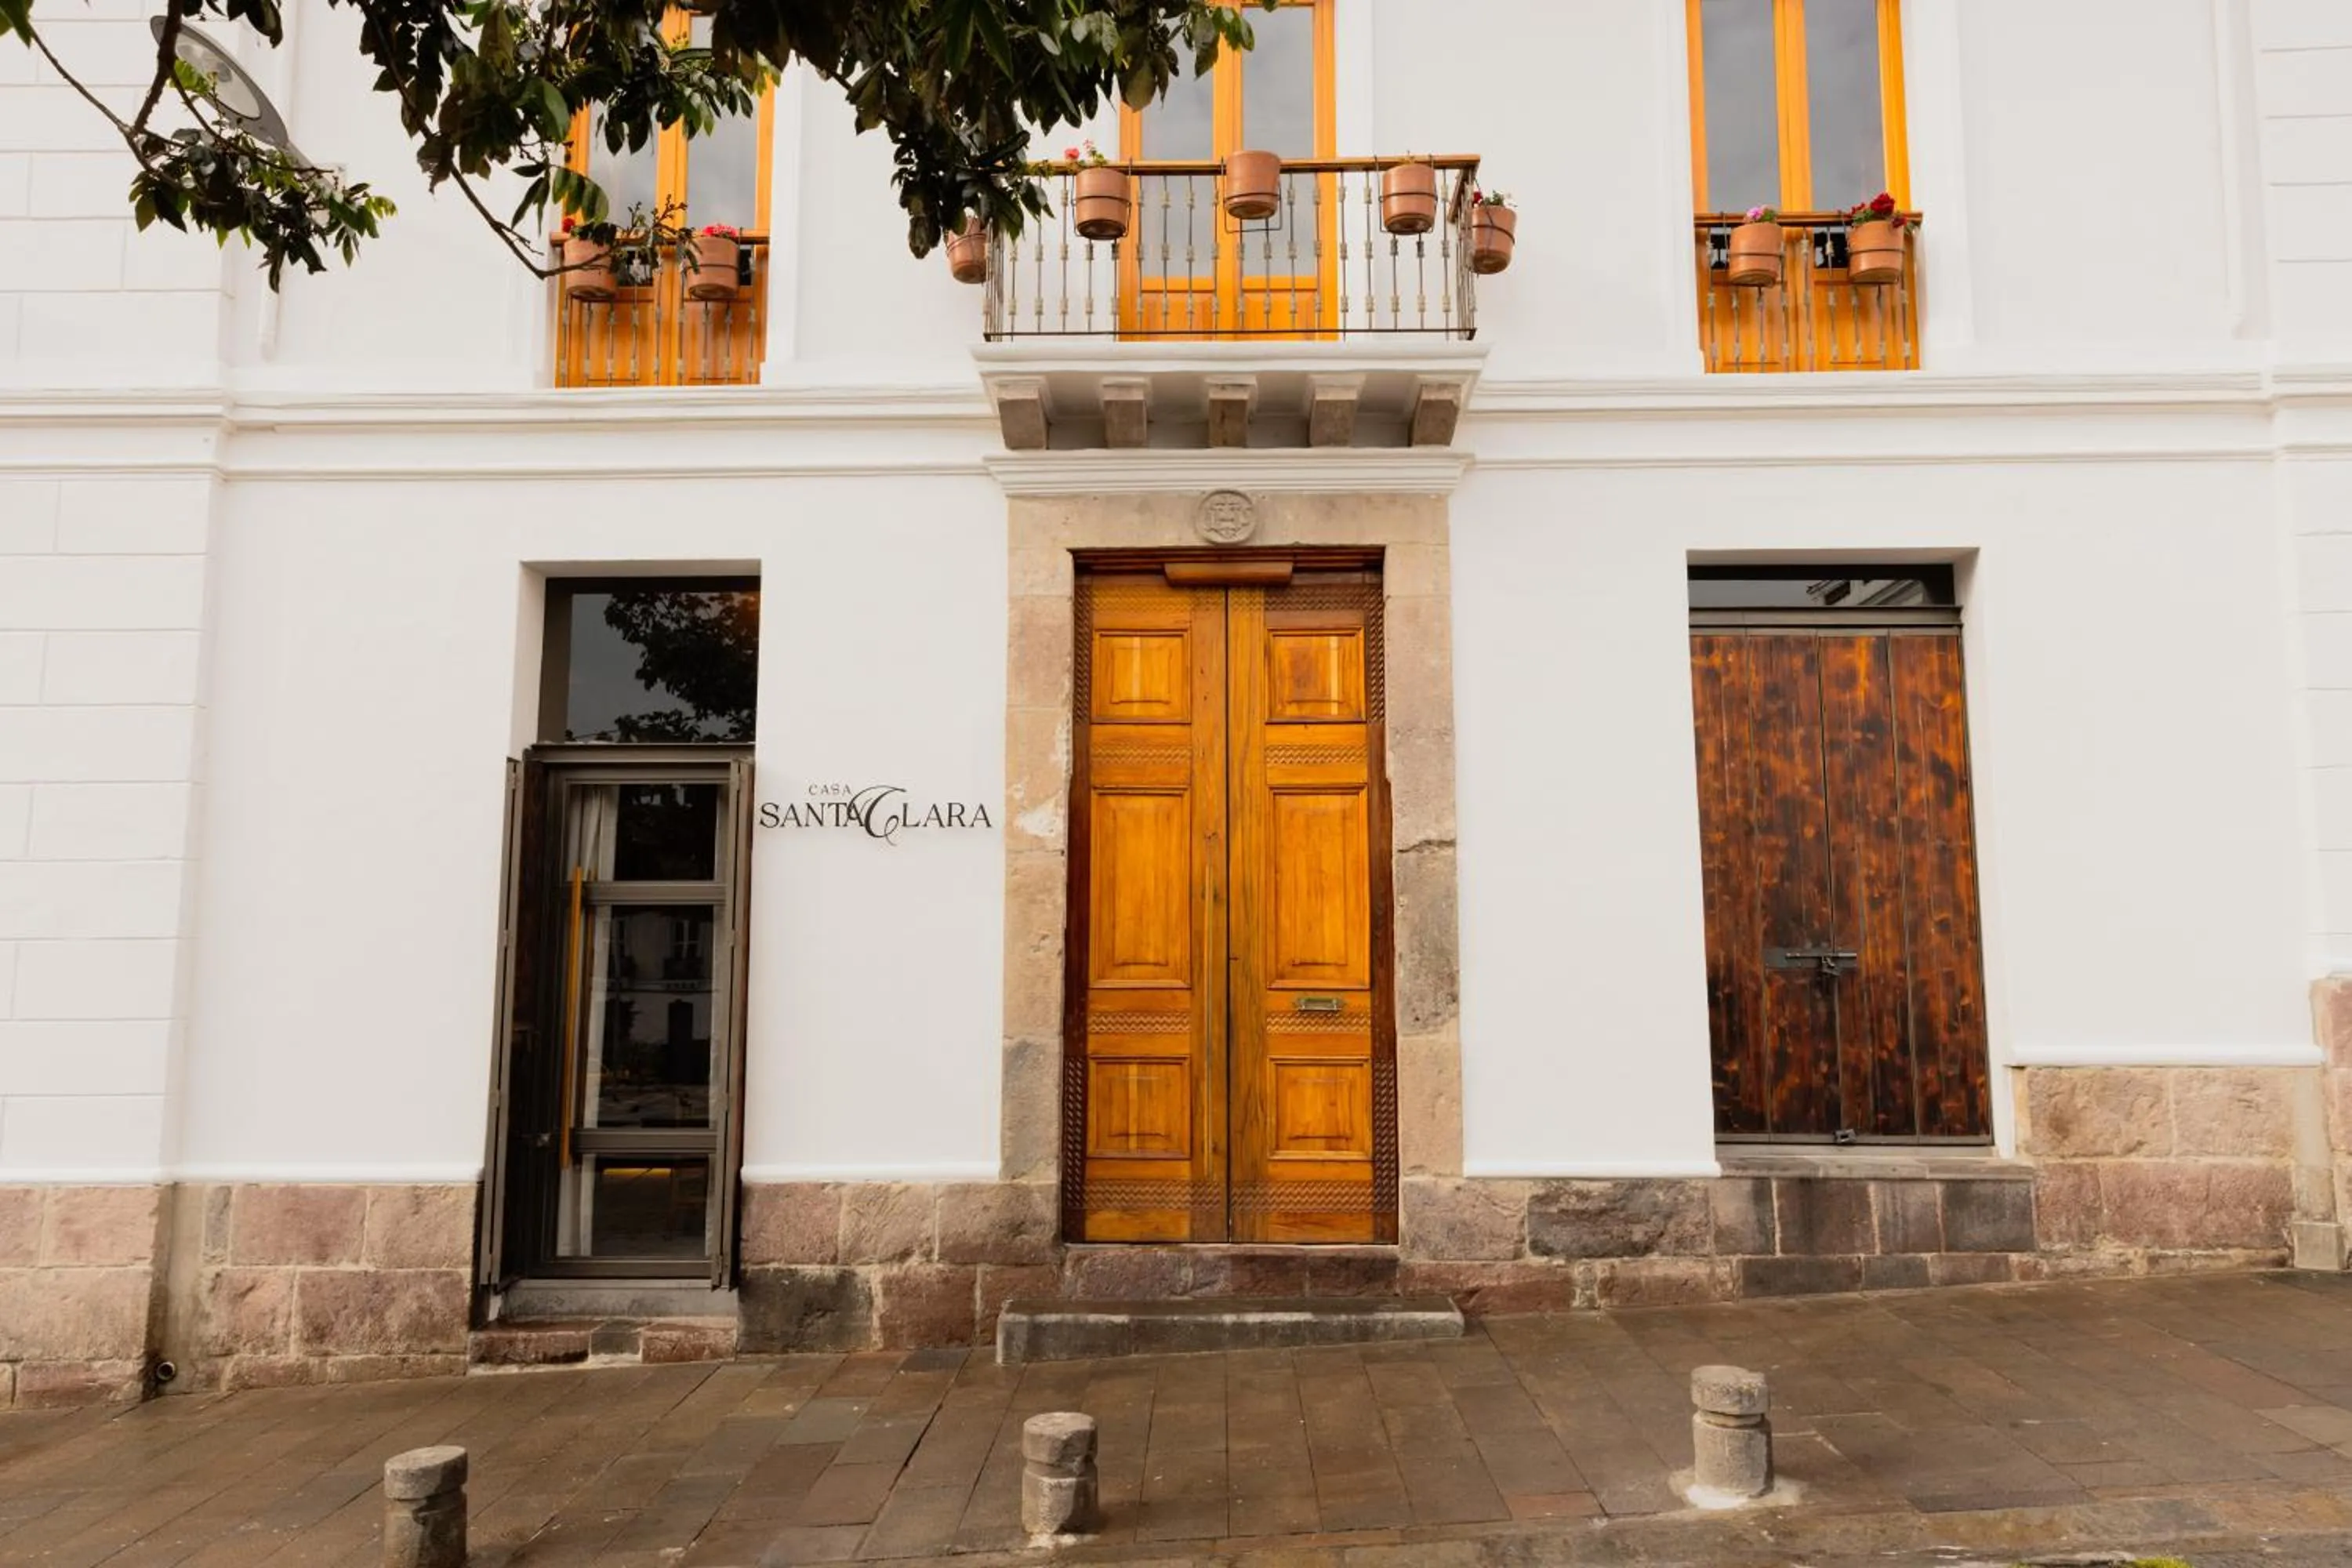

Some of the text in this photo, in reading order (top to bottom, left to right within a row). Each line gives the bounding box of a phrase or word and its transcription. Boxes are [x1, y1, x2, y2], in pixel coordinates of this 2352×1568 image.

[808, 783, 852, 796] CASA
[760, 785, 992, 846] SANTA CLARA
